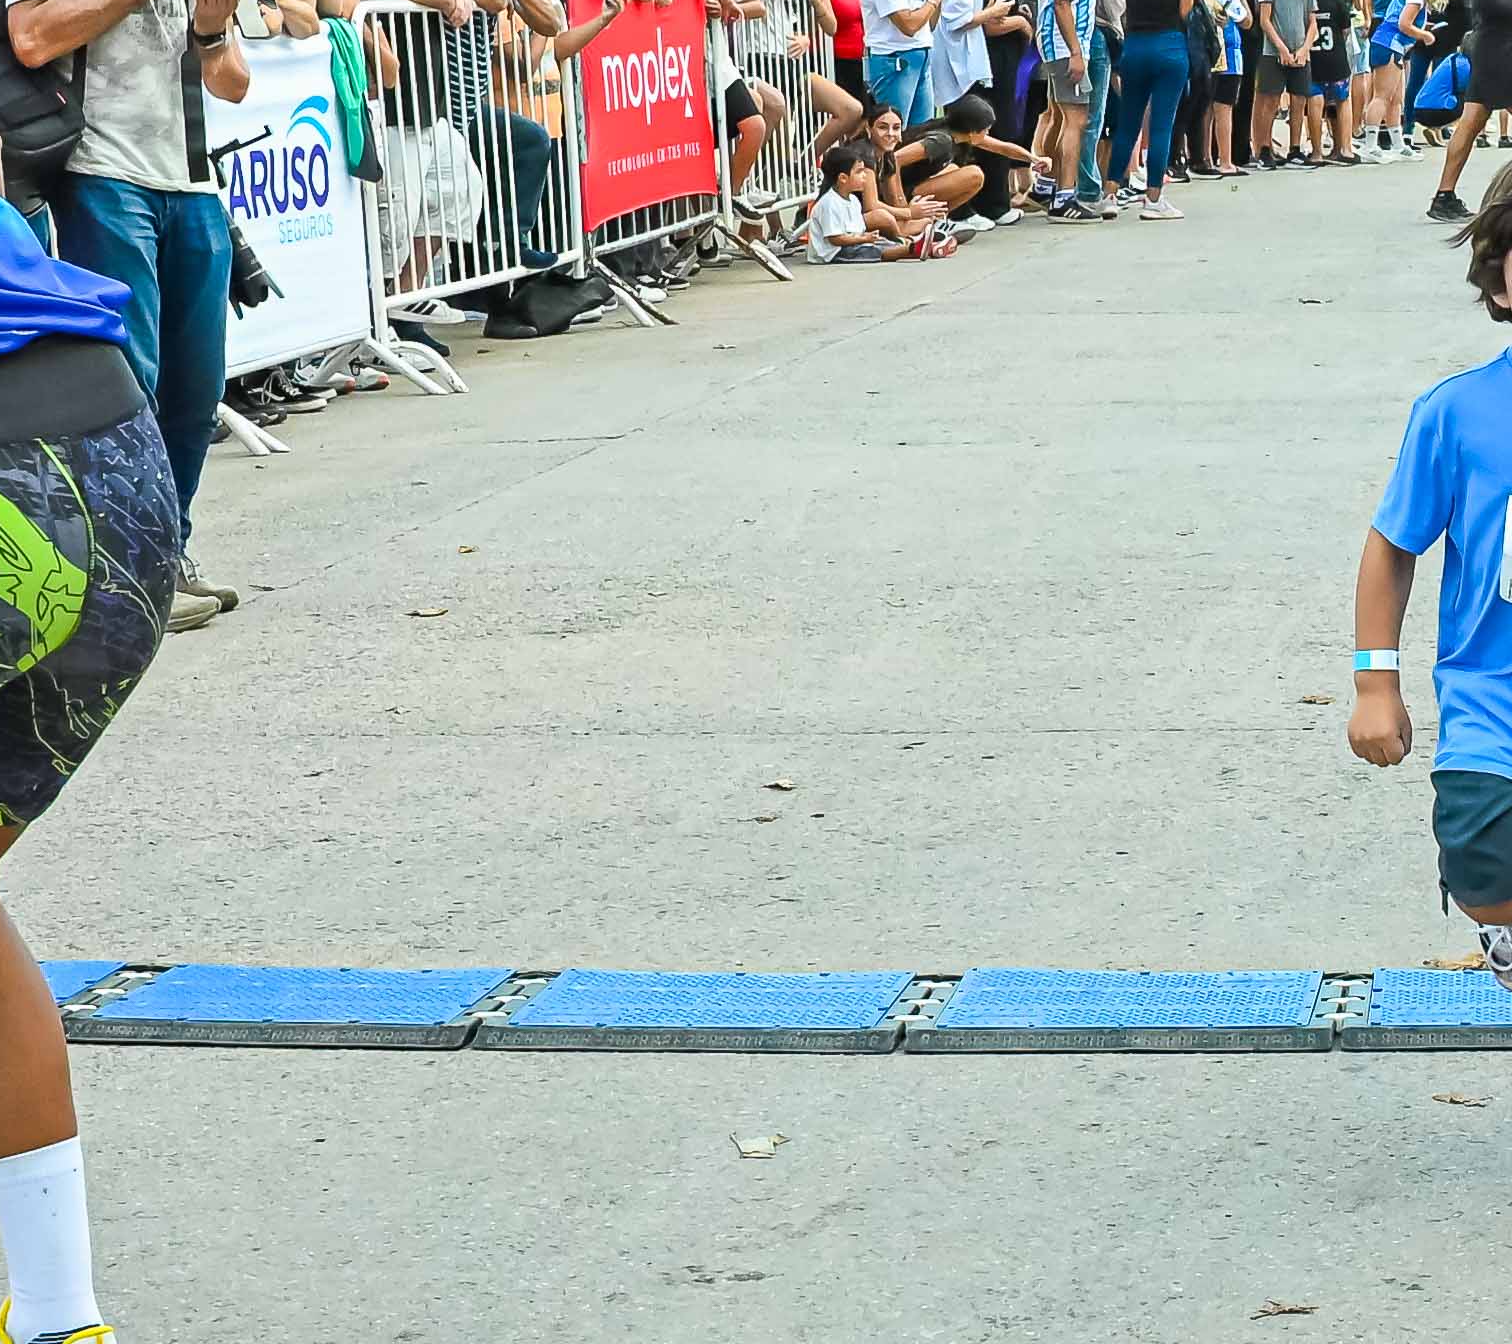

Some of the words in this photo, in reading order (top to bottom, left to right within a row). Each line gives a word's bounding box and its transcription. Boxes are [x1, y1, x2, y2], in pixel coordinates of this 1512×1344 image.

[601, 26, 694, 126] moplex
[229, 144, 330, 220] ARUSO
[278, 213, 334, 244] SEGUROS
